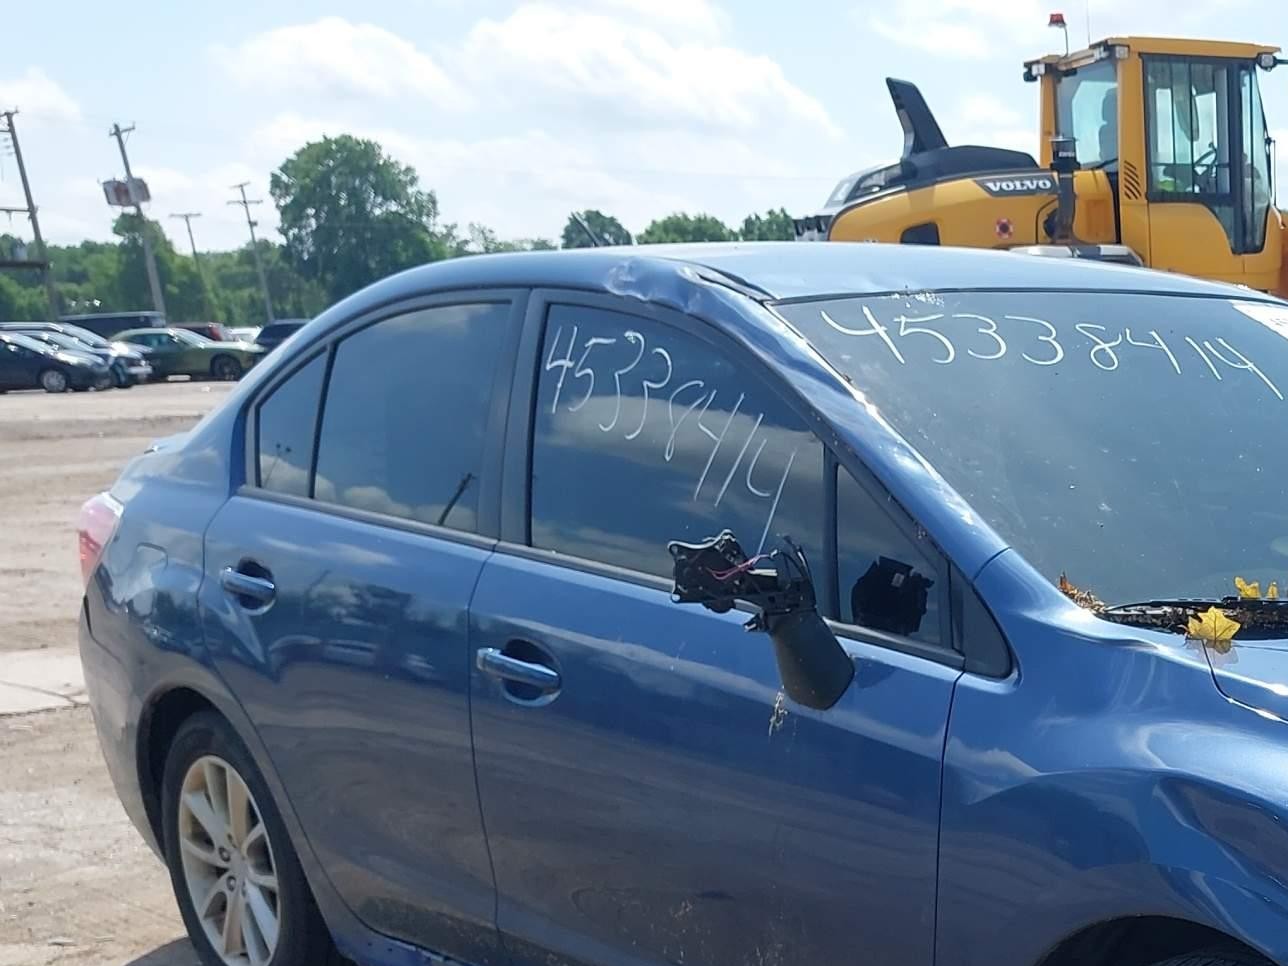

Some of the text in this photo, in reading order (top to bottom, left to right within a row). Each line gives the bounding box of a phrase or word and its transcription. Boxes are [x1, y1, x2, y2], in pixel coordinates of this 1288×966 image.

[985, 179, 1052, 192] VOLVO
[820, 304, 1284, 400] 45338414
[545, 326, 797, 554] 45338414
